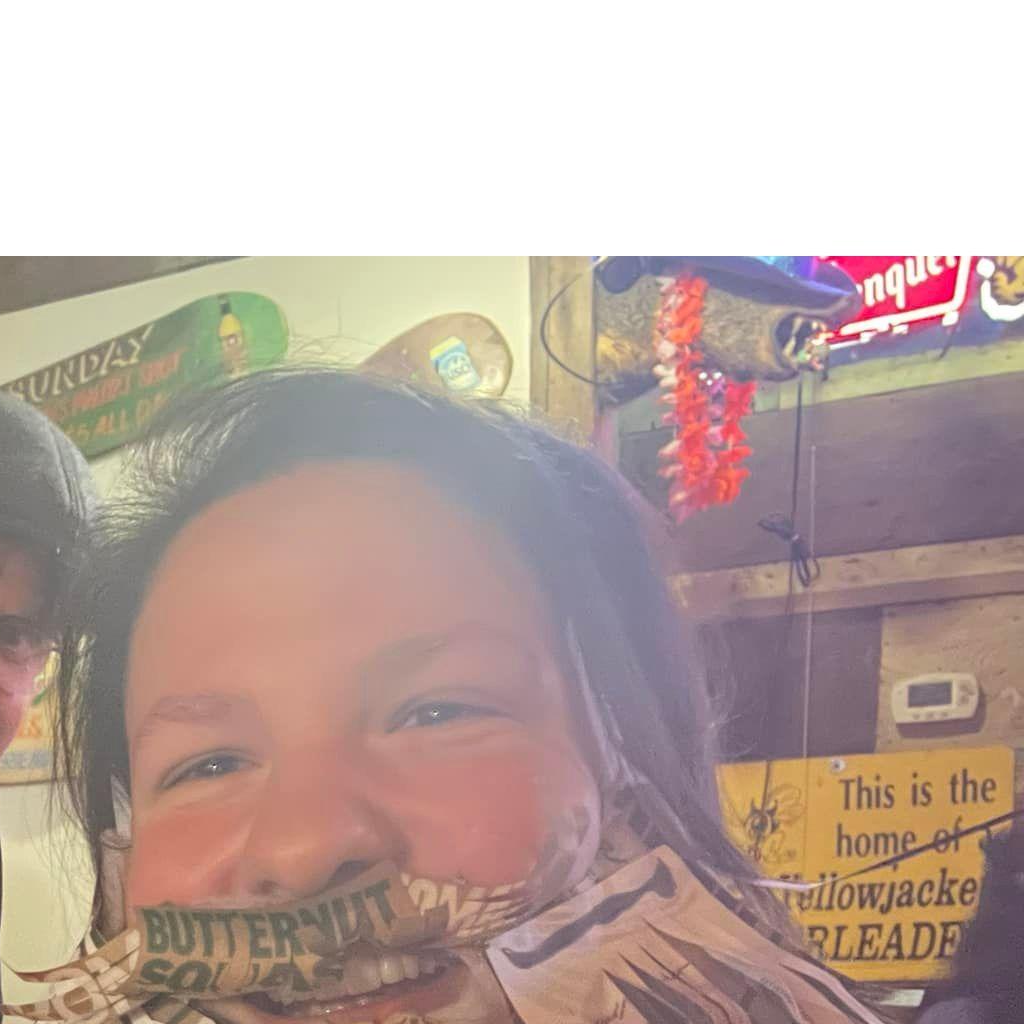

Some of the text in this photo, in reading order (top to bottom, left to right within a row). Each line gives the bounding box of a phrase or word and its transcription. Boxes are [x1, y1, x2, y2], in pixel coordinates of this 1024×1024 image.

[9, 323, 154, 403] SUNDAY
[839, 768, 997, 811] This is the
[836, 815, 964, 858] home of
[142, 879, 397, 958] BUTTERNUT
